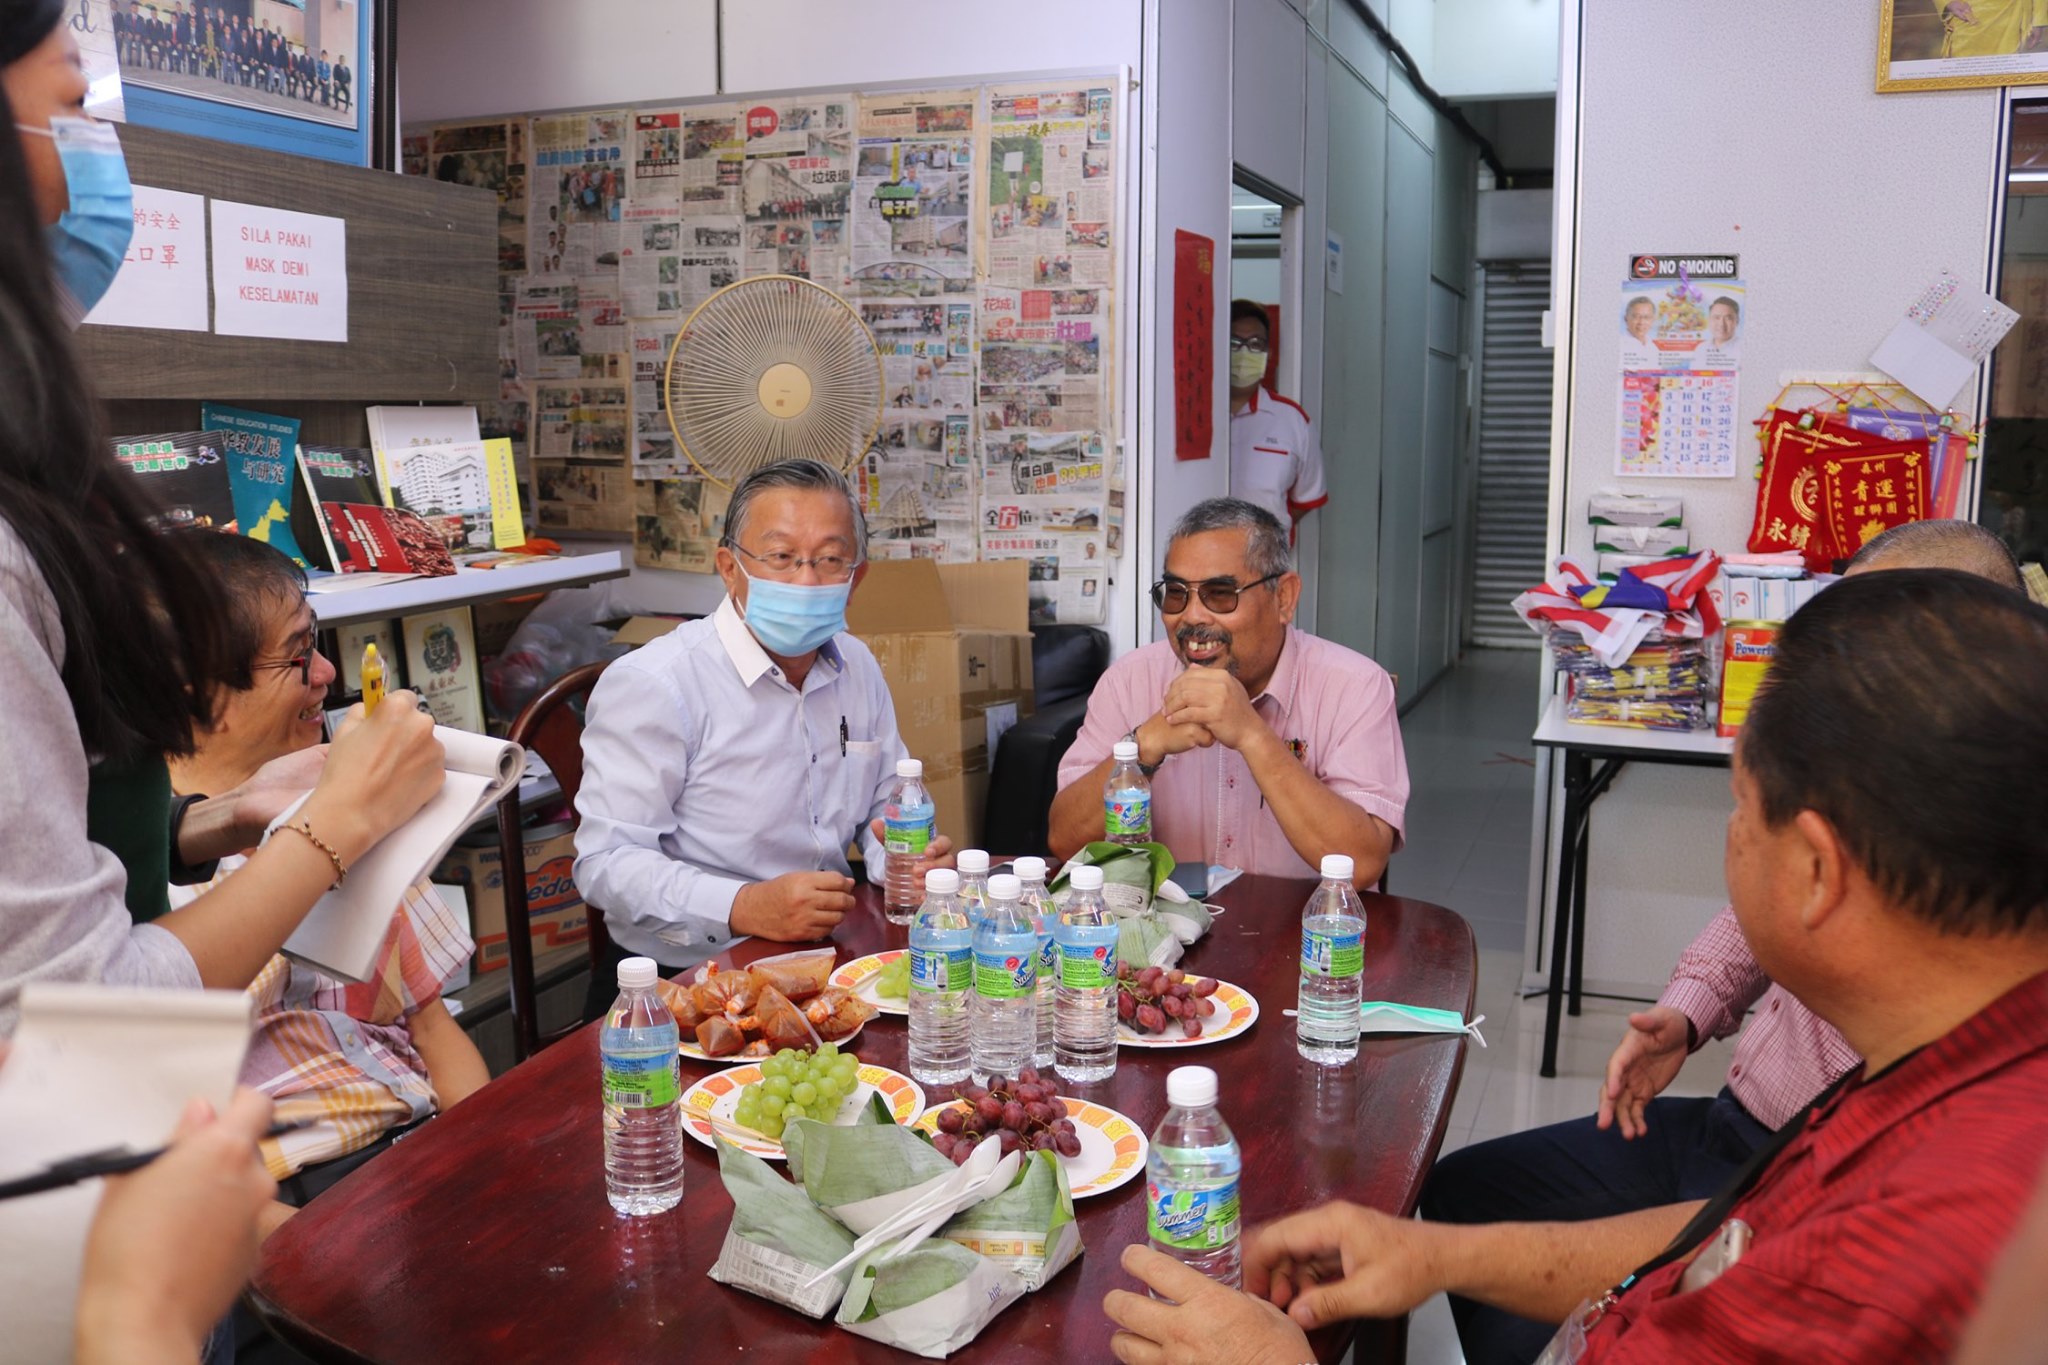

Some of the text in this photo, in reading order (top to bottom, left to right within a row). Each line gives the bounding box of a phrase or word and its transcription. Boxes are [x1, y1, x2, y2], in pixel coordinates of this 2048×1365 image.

[241, 226, 311, 249] SILA PAKAI
[245, 256, 310, 277] MASK DEMI
[1659, 260, 1676, 274] NO
[239, 285, 320, 306] KESELAMATAN
[1683, 392, 1693, 400] 10
[1702, 392, 1712, 401] 17
[1682, 417, 1692, 425] 12
[1701, 417, 1711, 425] 19
[1718, 417, 1731, 425] 26
[1682, 430, 1692, 438] 13
[1718, 430, 1730, 439] 27
[1698, 454, 1710, 462] 22
[1717, 454, 1729, 462] 29
[1851, 478, 1898, 502] 青運
[986, 506, 1032, 530] 全方位
[527, 875, 577, 901] eda
[1156, 1203, 1208, 1228] Summer
